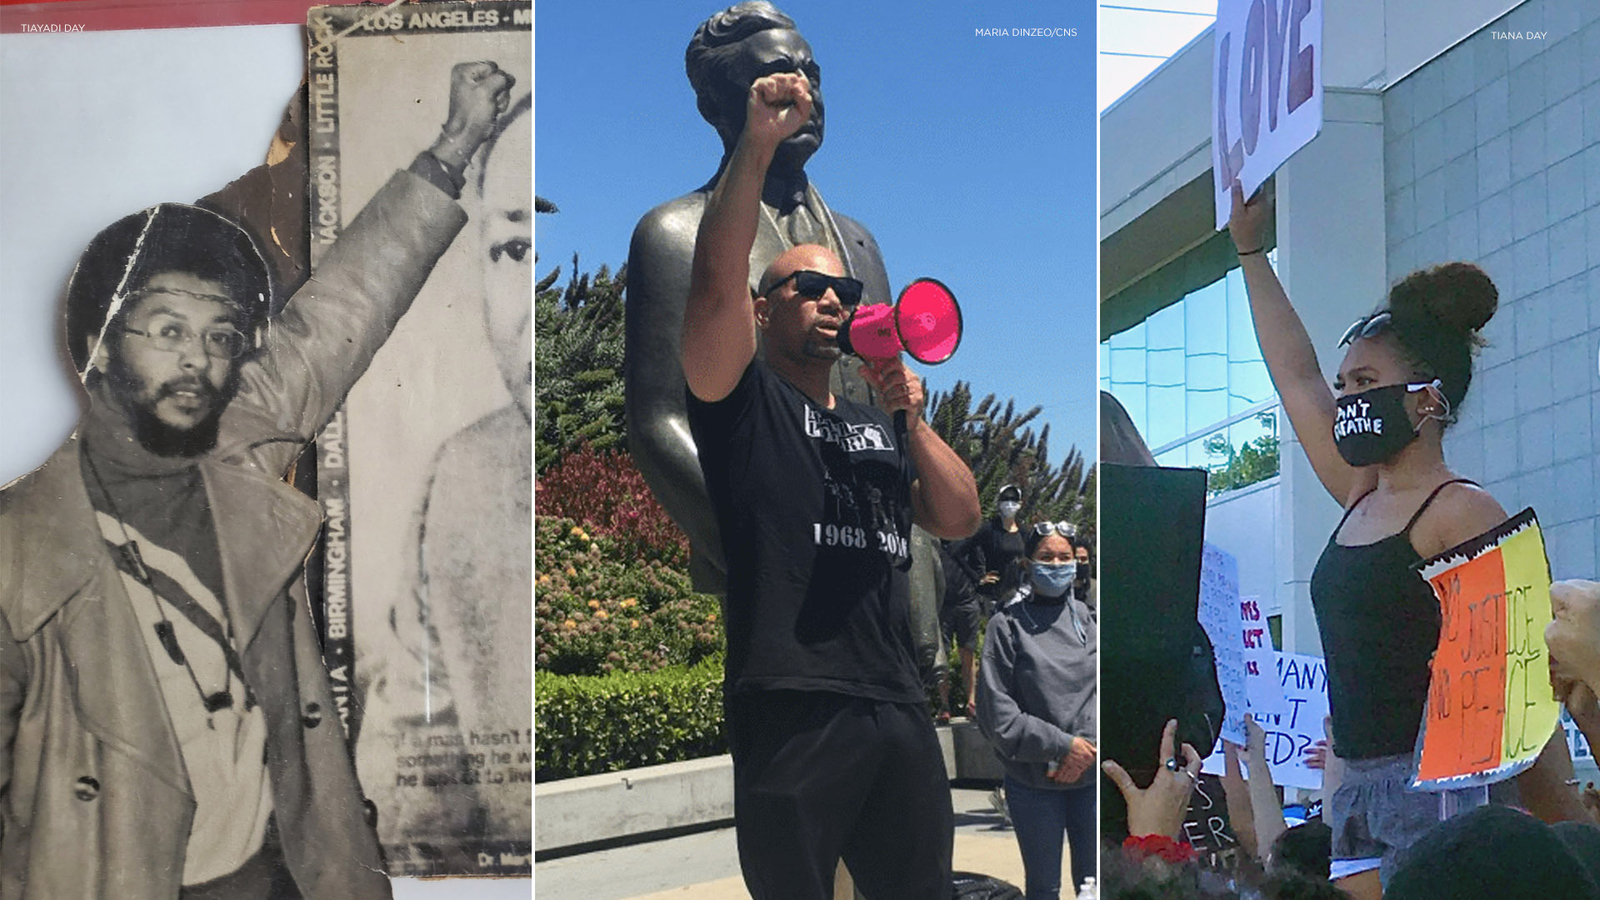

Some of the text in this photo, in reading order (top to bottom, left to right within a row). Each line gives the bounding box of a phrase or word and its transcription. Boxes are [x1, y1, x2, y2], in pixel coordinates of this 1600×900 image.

[361, 8, 532, 31] LOS ANGELES M
[316, 73, 335, 134] LITTLE
[1217, 0, 1315, 193] LOVE
[812, 522, 868, 550] 1968
[325, 498, 347, 639] BIRMINGHAM
